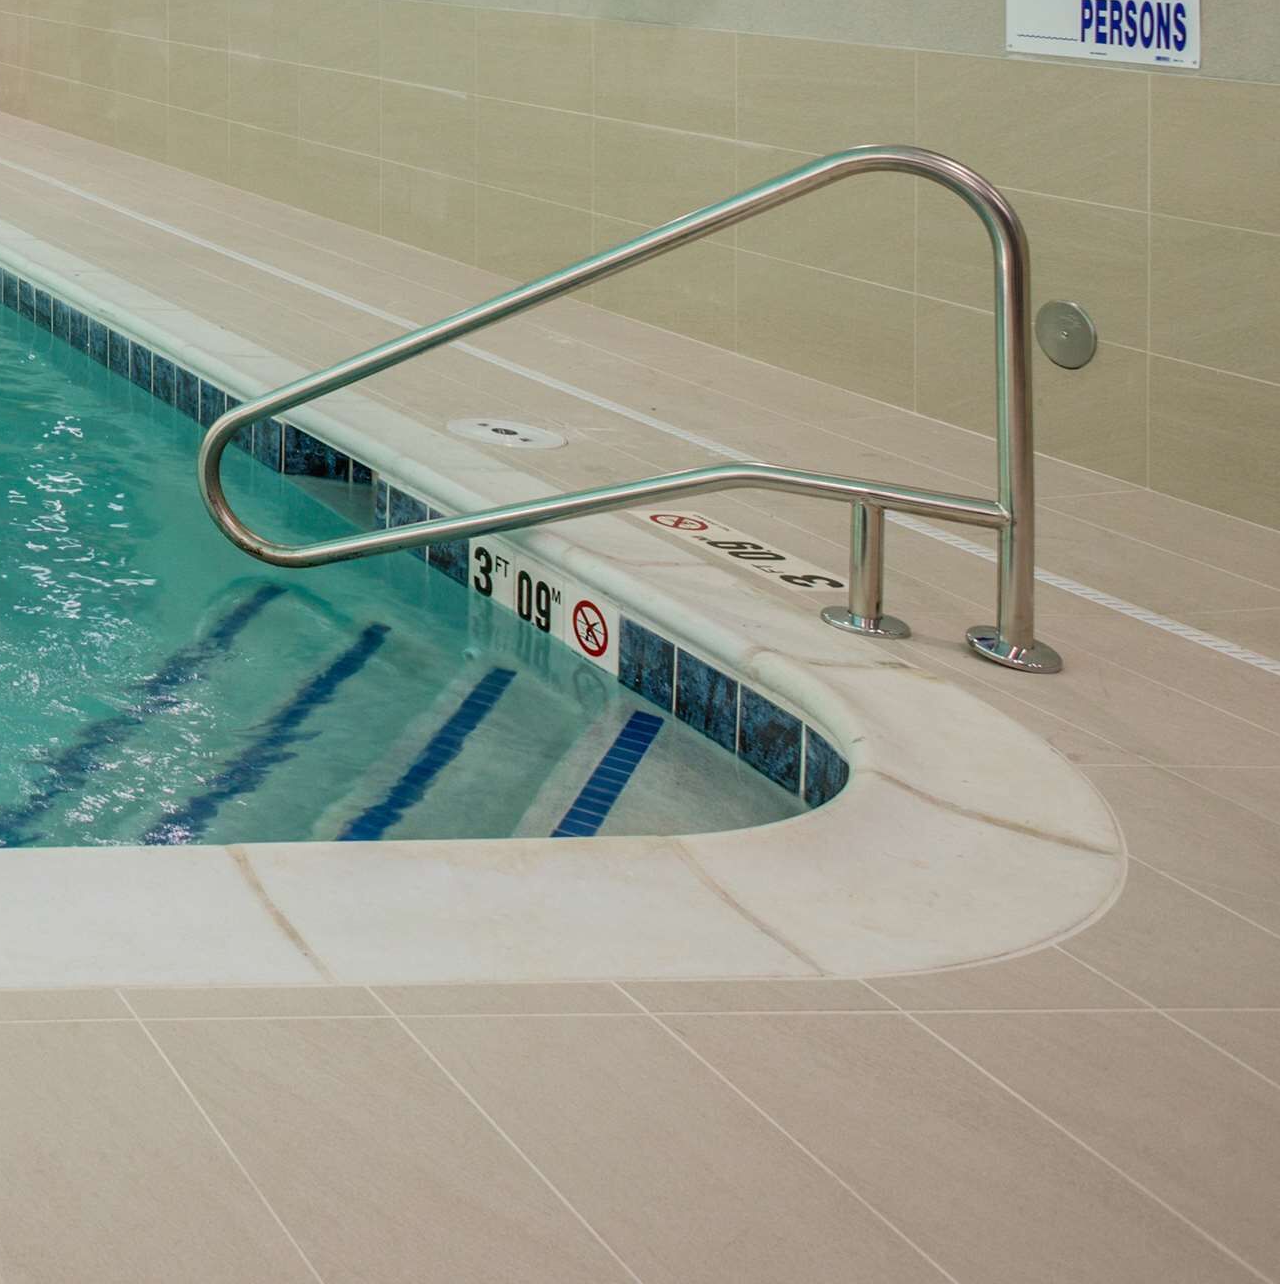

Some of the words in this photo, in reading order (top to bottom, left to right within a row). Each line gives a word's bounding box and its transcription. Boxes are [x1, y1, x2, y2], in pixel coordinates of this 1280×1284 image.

[474, 546, 493, 597] 3
[496, 555, 510, 578] FT
[552, 587, 561, 605] M
[780, 575, 844, 588] 3
